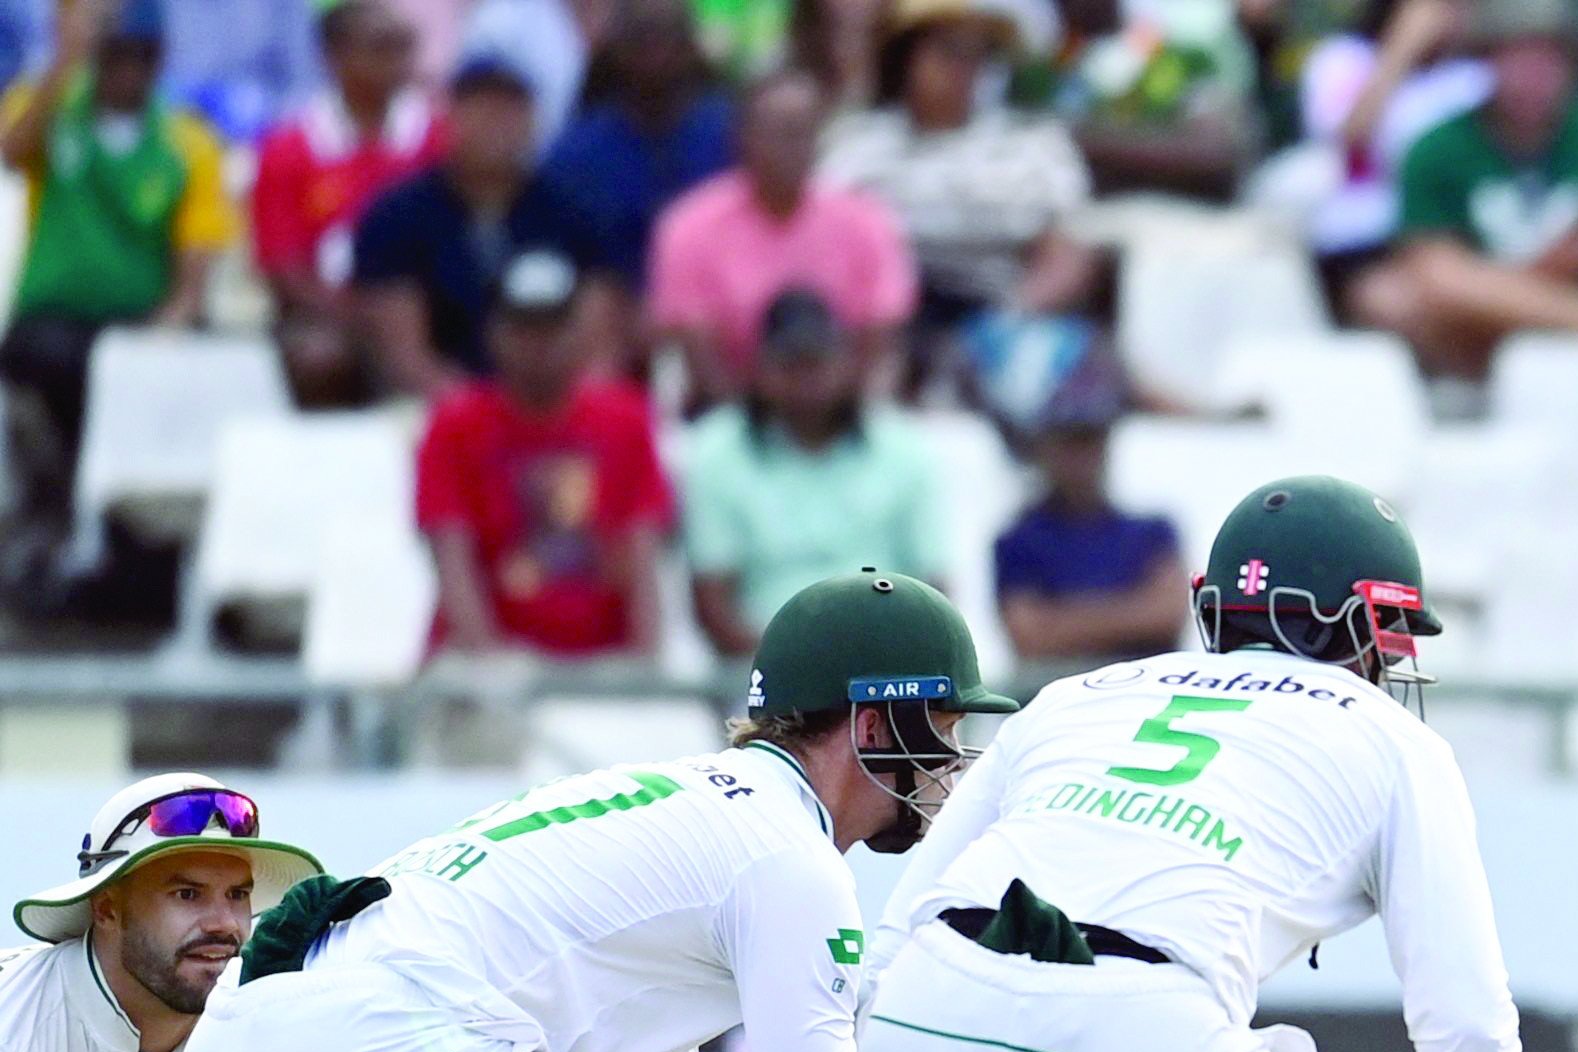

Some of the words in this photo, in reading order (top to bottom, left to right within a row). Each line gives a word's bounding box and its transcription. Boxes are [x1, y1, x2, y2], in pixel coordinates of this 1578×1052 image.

[883, 682, 919, 697] AIR
[1159, 671, 1357, 711] dafabet
[1106, 695, 1254, 787] 5
